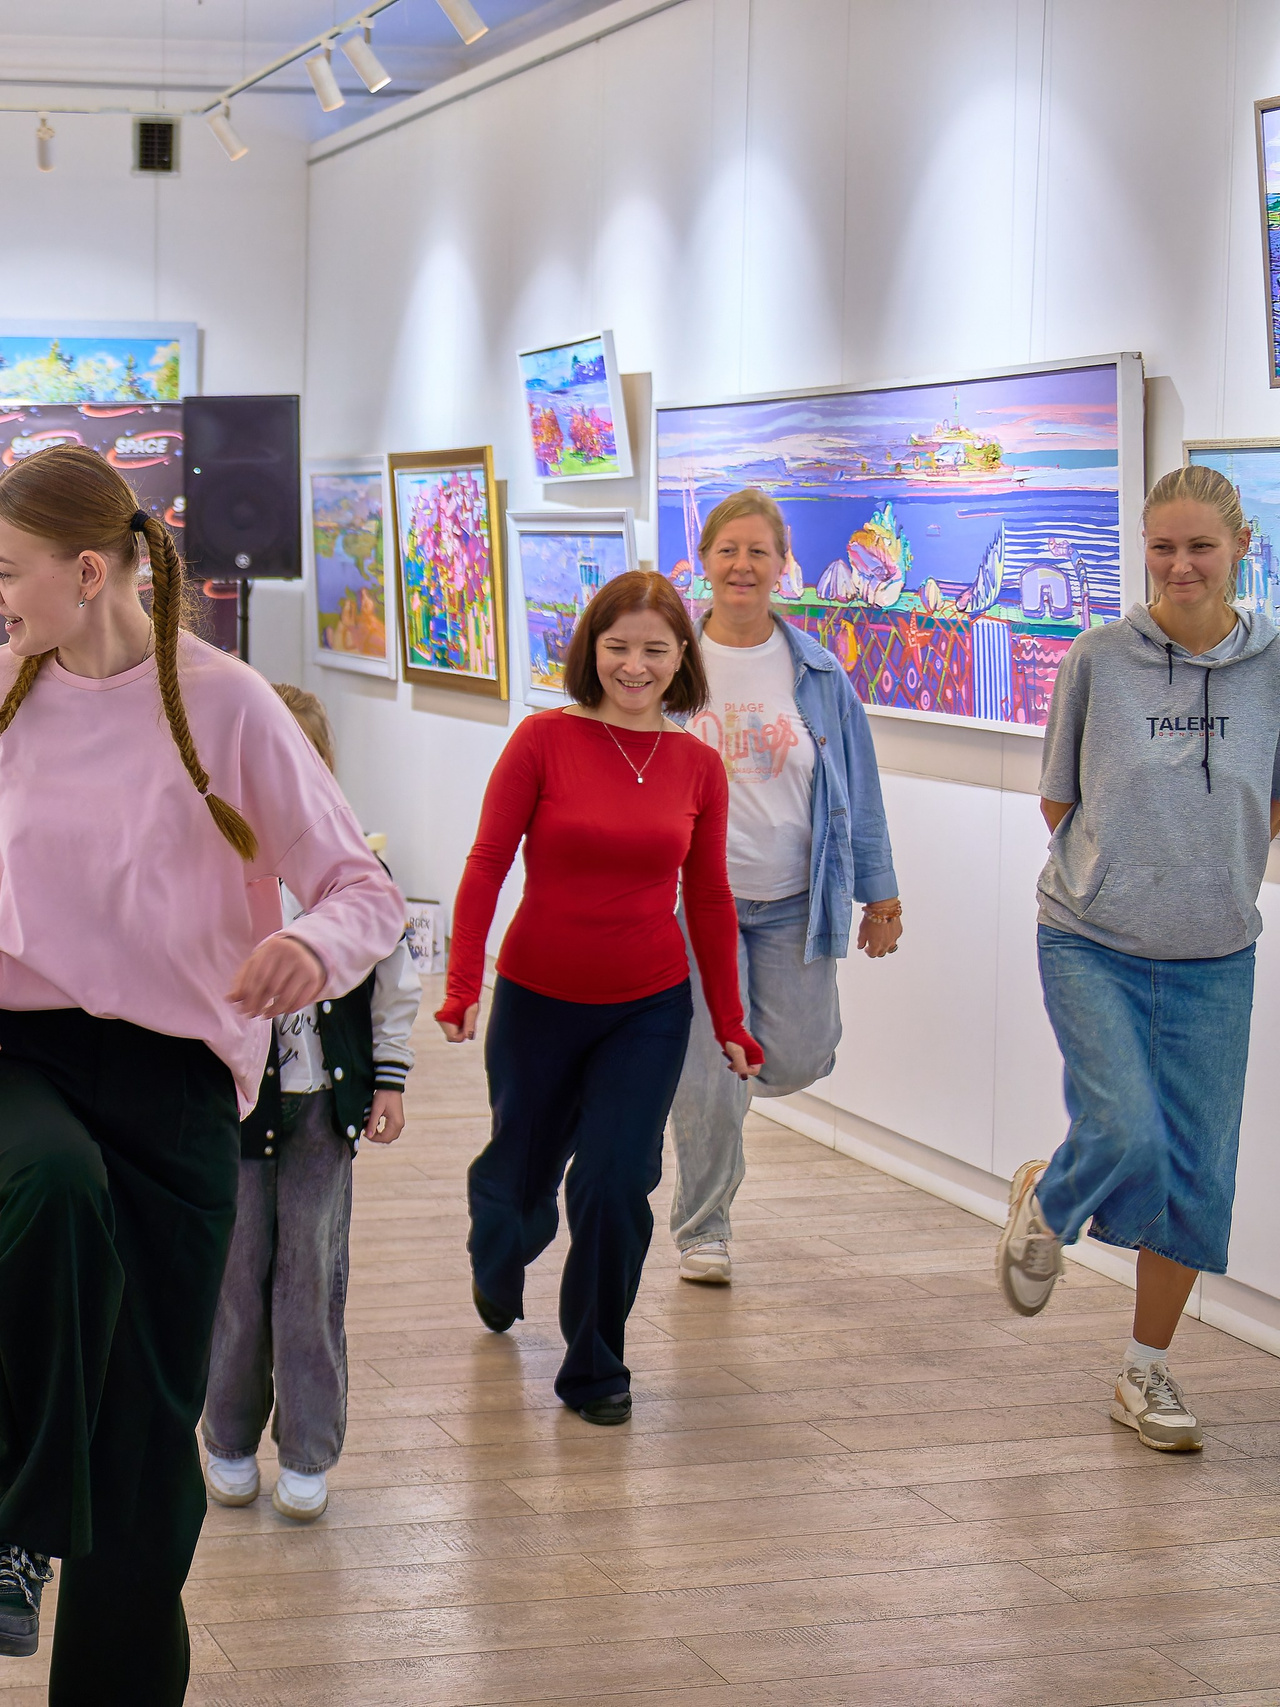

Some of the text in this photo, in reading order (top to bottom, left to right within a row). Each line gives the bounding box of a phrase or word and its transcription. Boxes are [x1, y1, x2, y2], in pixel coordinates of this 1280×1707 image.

[115, 436, 169, 454] SPACE
[724, 703, 764, 713] PLAGE
[1146, 716, 1230, 740] TALENT
